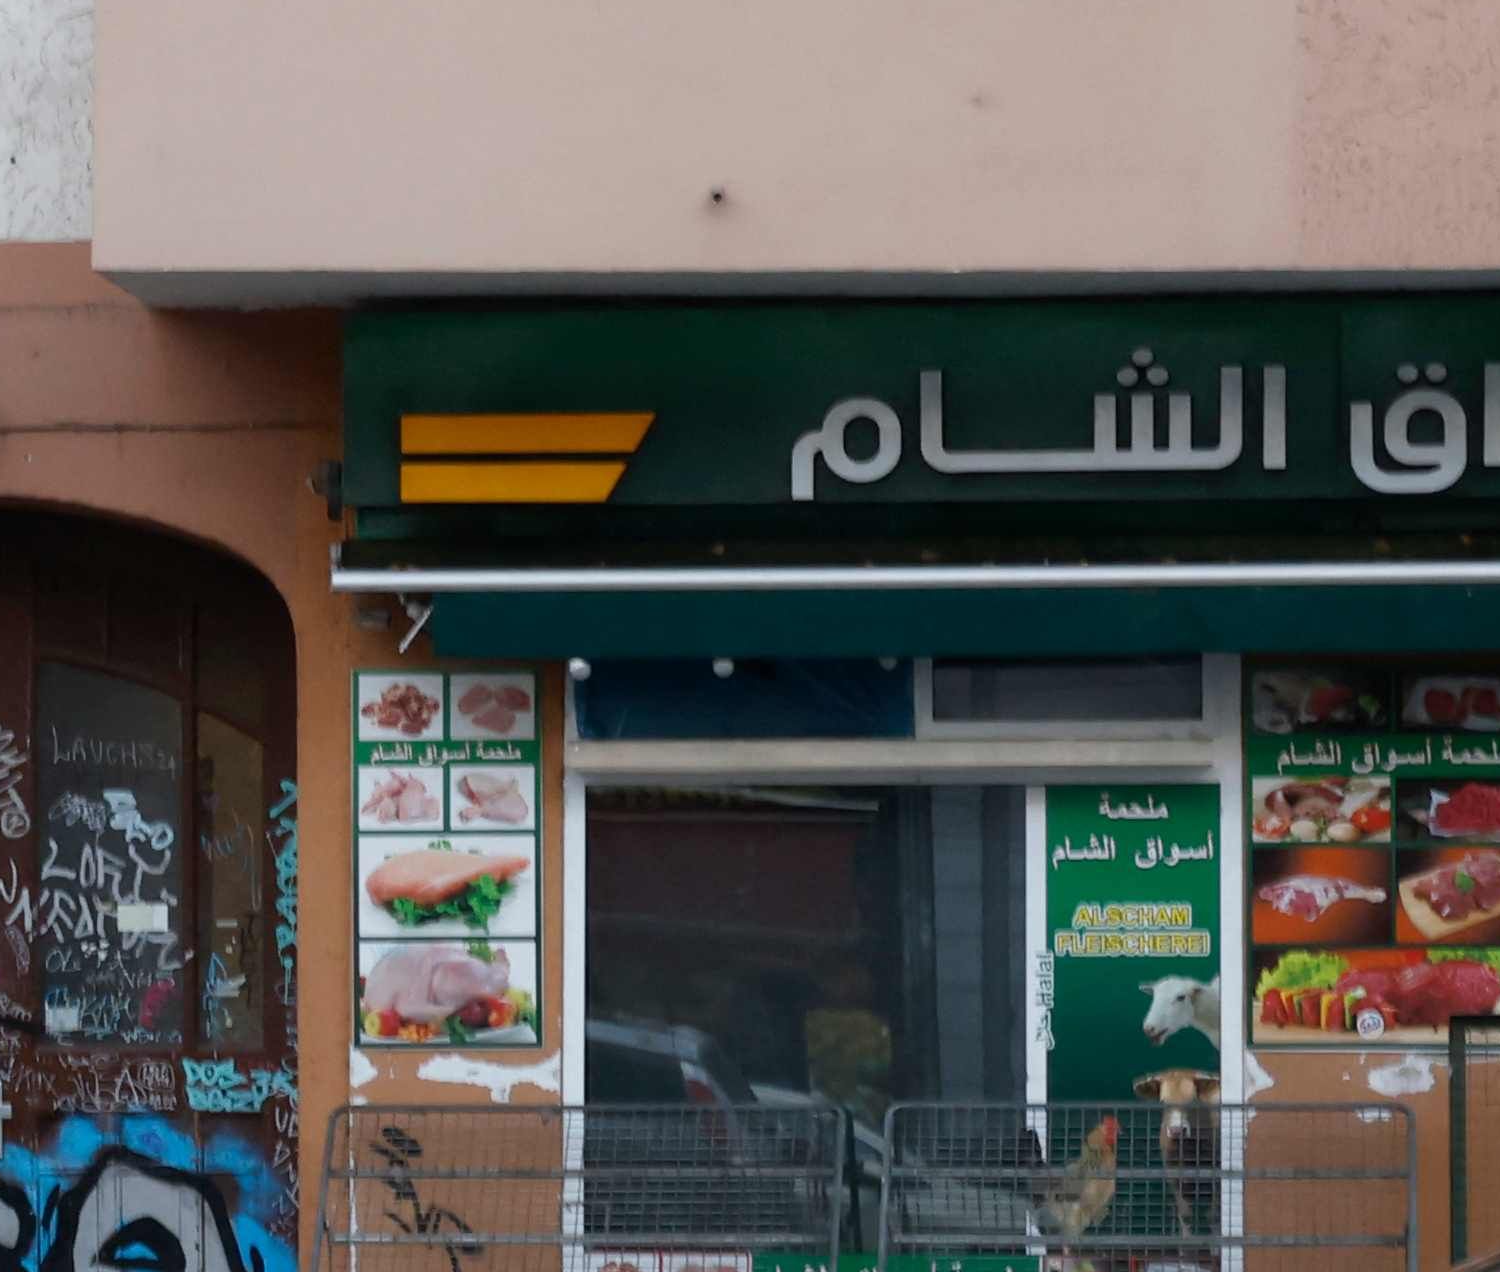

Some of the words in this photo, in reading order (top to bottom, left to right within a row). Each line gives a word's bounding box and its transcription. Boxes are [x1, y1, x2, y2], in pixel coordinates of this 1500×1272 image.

[791, 347, 1286, 500] الشام
[1277, 739, 1342, 776] الشام
[1352, 737, 1432, 774] أسواق
[1099, 792, 1169, 820] ملحمة
[1052, 833, 1117, 871] الشام
[1134, 829, 1214, 870] أسواق
[1072, 900, 1193, 929] ALSCHAM
[1054, 930, 1211, 957] FLEISCHEREI
